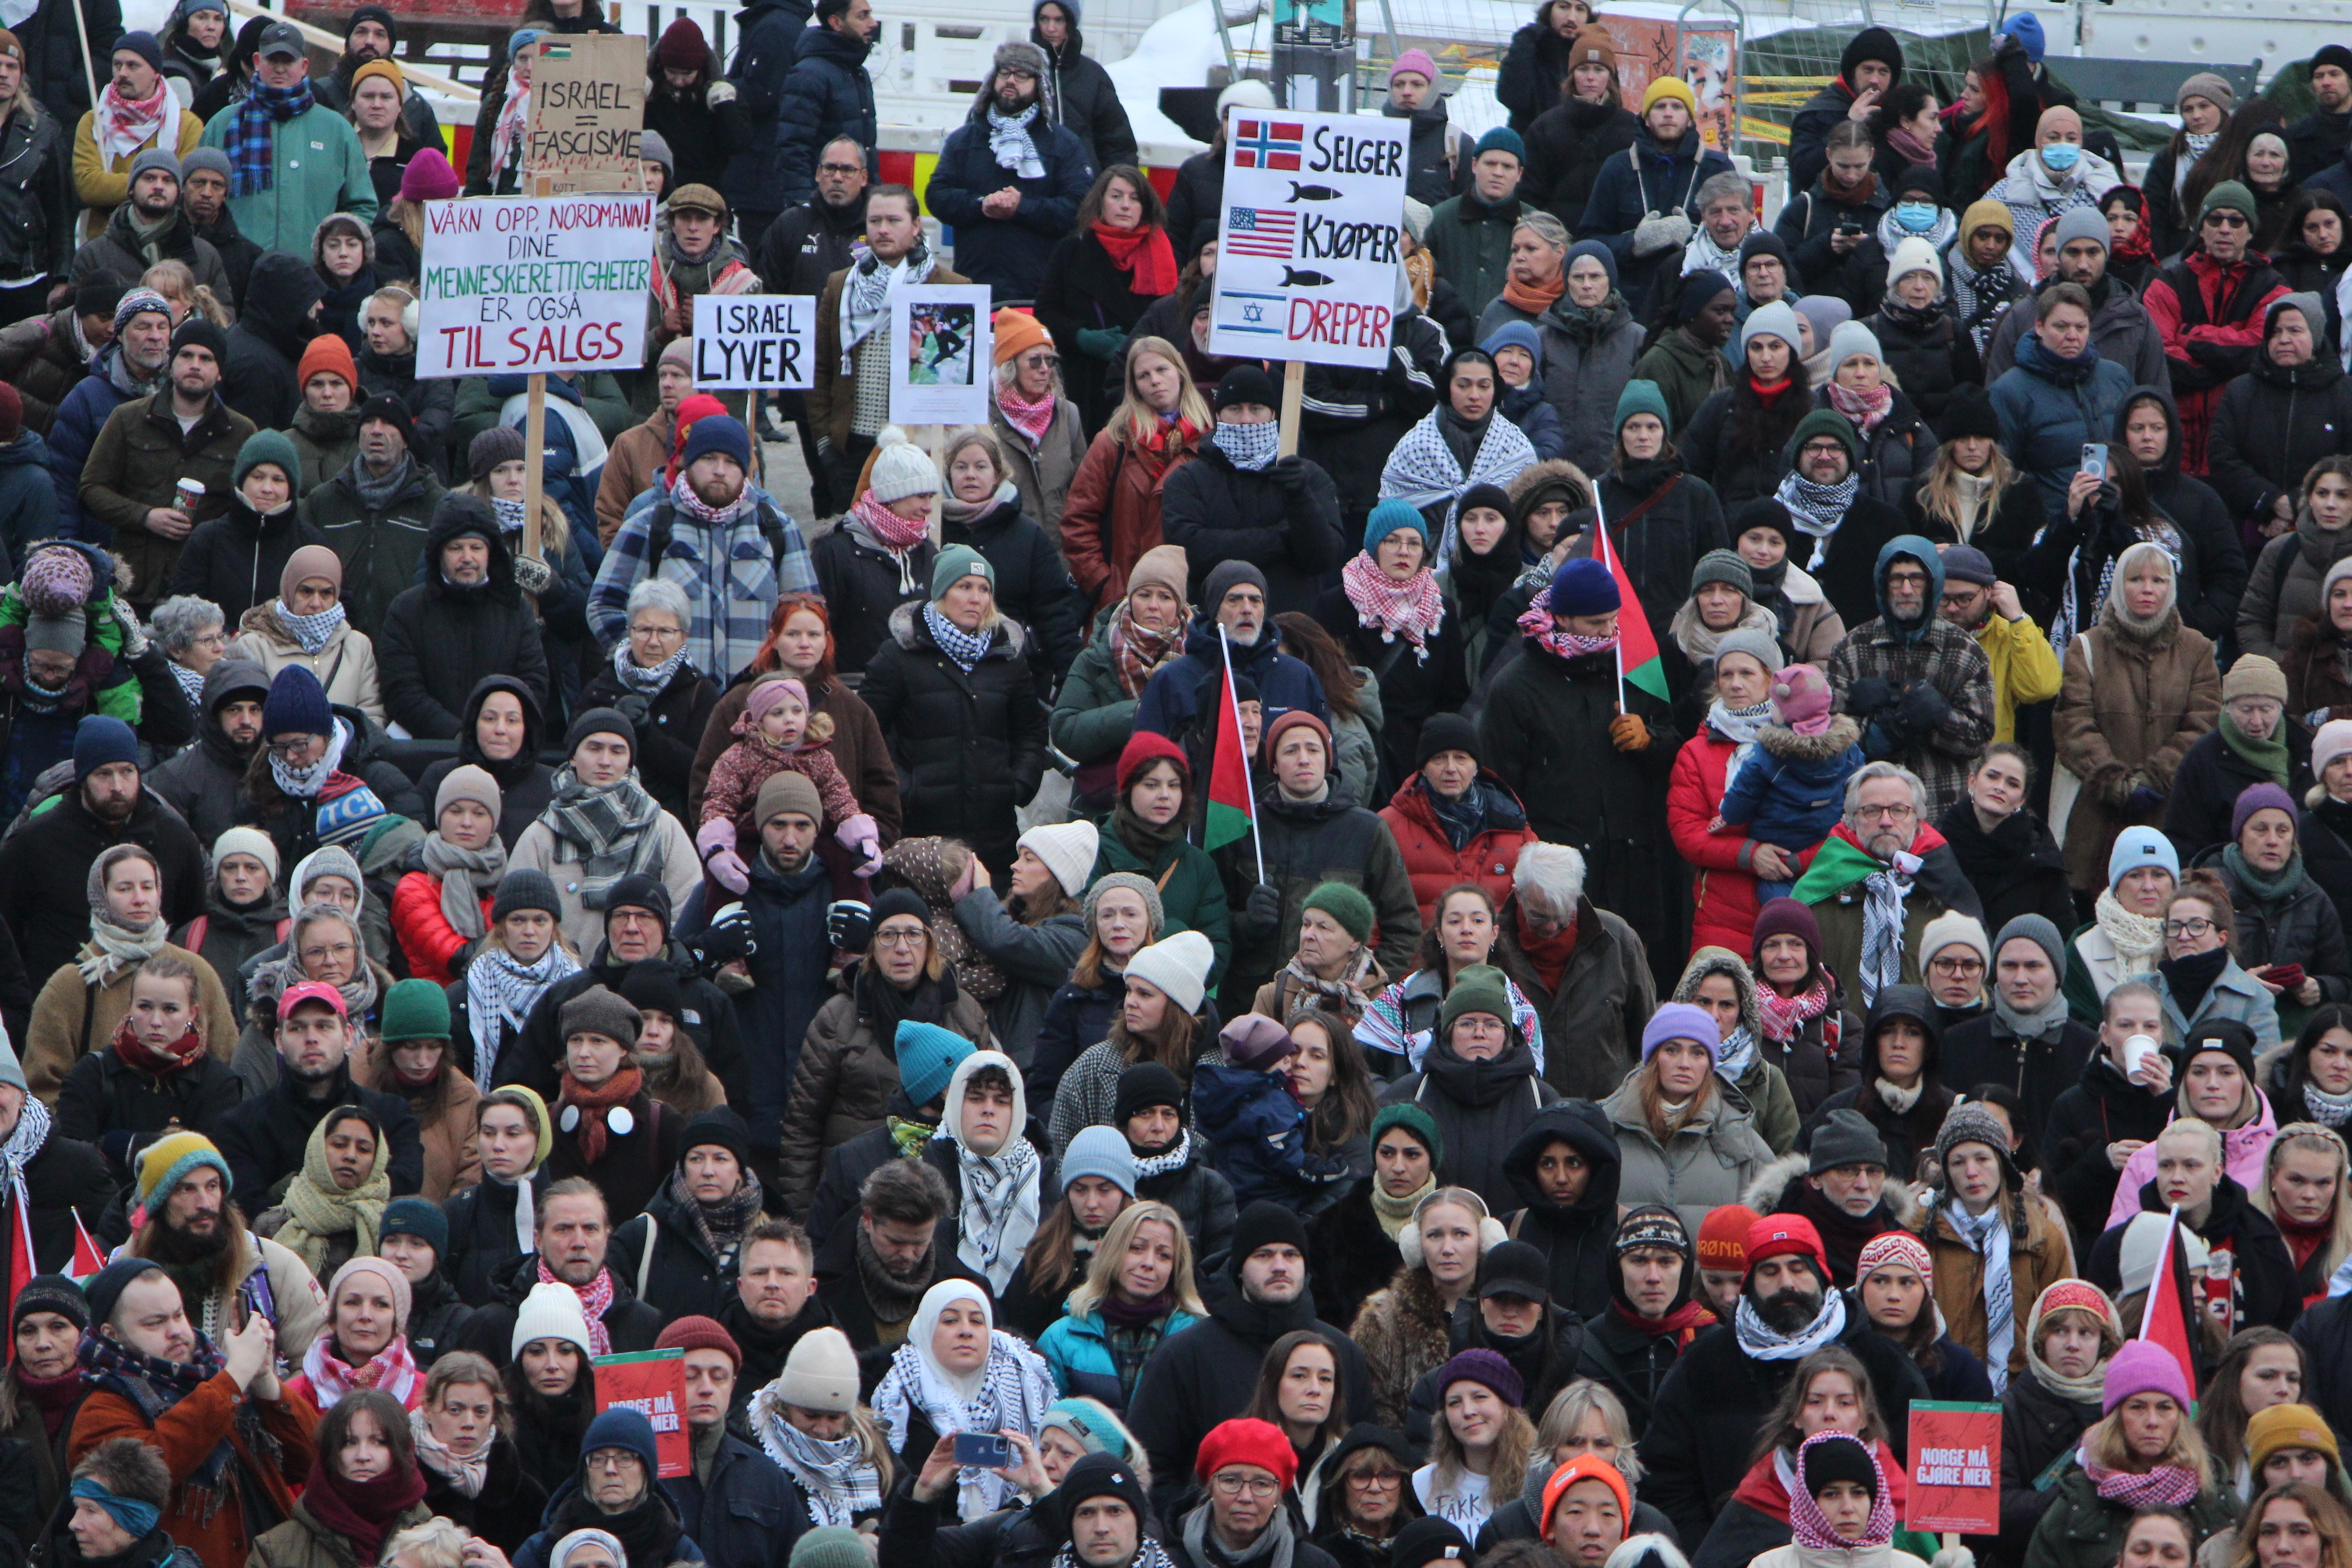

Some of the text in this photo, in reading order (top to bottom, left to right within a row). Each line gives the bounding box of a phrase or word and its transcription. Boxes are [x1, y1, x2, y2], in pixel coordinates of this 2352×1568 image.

[540, 81, 630, 109] ISRAEL
[532, 129, 642, 159] FASCISME
[1308, 125, 1402, 177] SELGER
[429, 199, 651, 235] VÅKN OPP, NORDMANN!
[509, 234, 558, 260] DINE
[1301, 212, 1398, 264] KJØPER
[424, 259, 650, 300] MENNESKERETTIGHETER
[481, 292, 582, 322] ER OGSÅ
[716, 304, 801, 333] ISRAEL
[1287, 297, 1390, 348] DREPER
[440, 322, 623, 368] TIL SALGS
[697, 338, 802, 382] LYVER
[653, 1391, 675, 1413] MÅ
[651, 1413, 679, 1432] MER
[1920, 1445, 1989, 1467] NORGE MÅ
[1916, 1466, 1992, 1486] GJØRE MER
